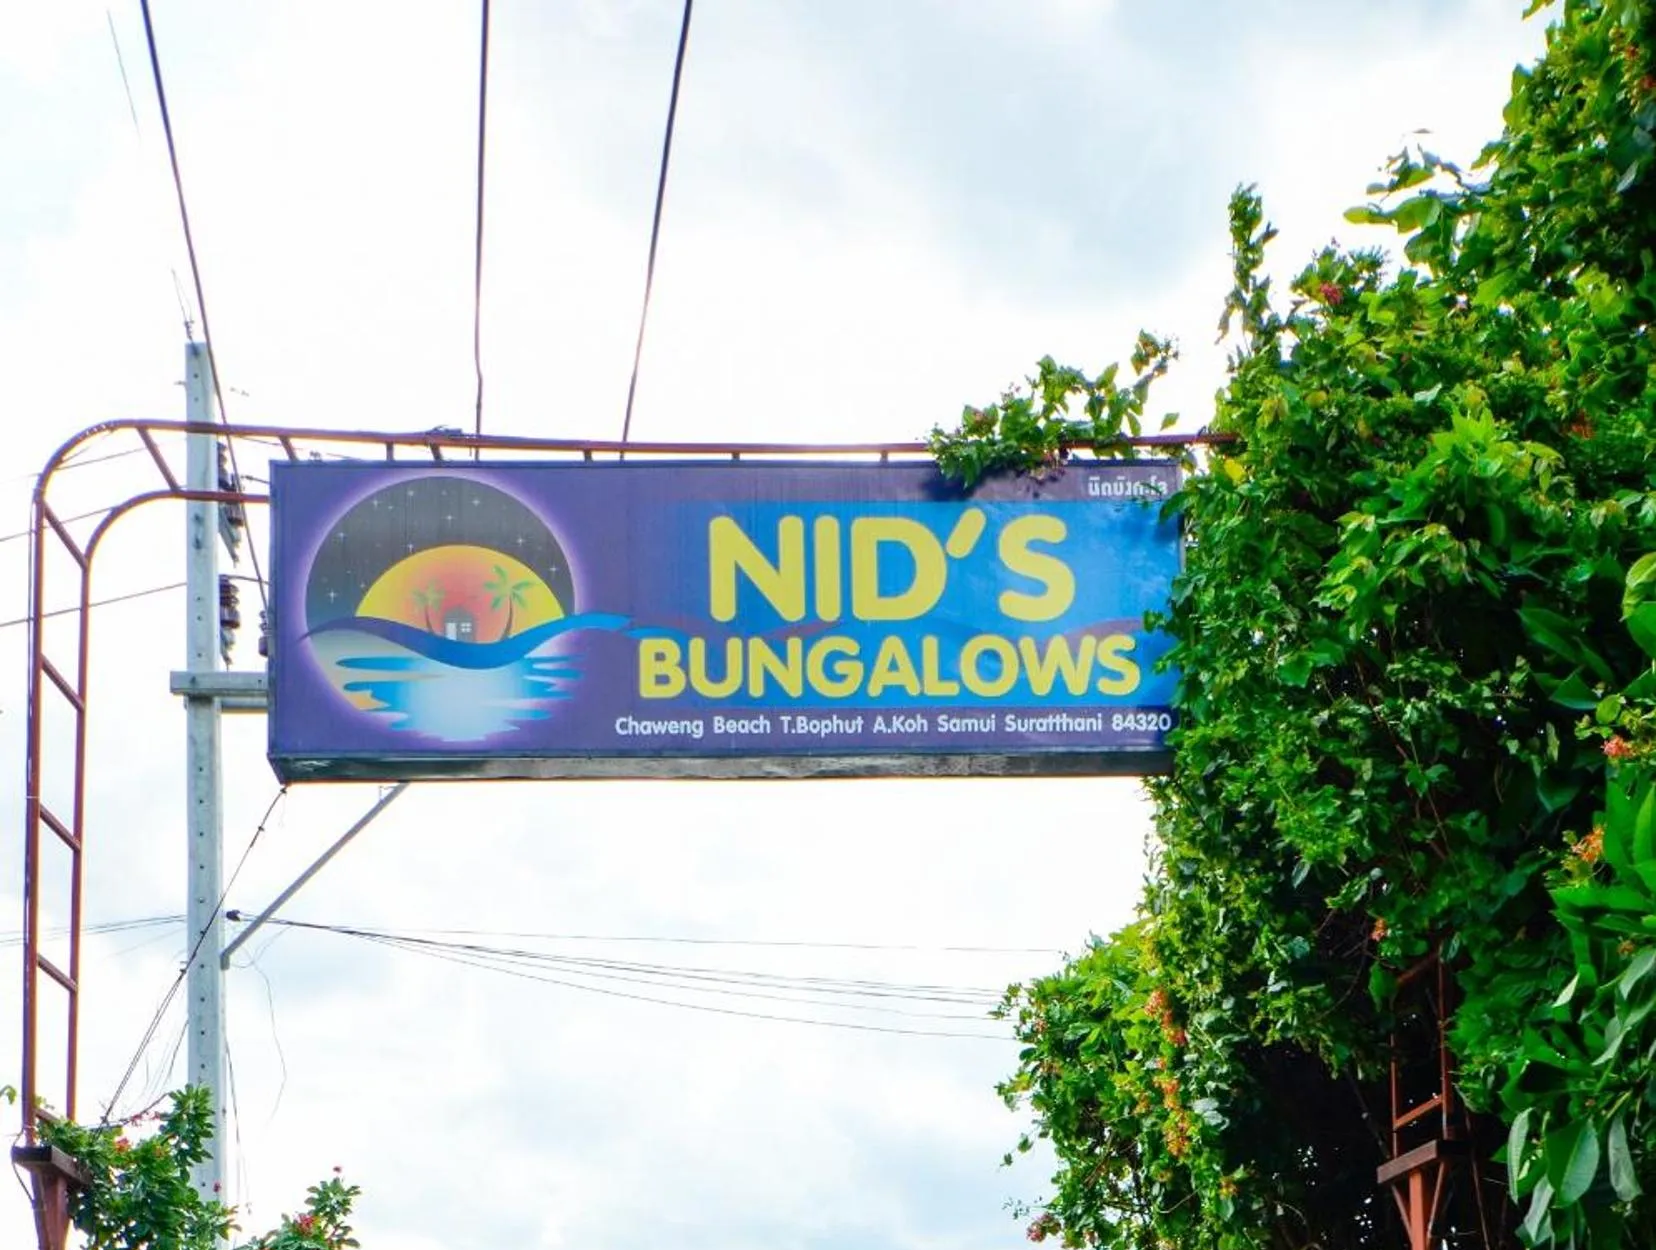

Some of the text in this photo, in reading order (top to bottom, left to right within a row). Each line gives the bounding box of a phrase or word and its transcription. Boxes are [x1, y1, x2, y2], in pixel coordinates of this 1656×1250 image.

[639, 634, 1141, 698] BUNGALOWS
[615, 712, 1172, 738] Chaweng Beach T.Bophut A.Koh Samui Suratthani 84320
